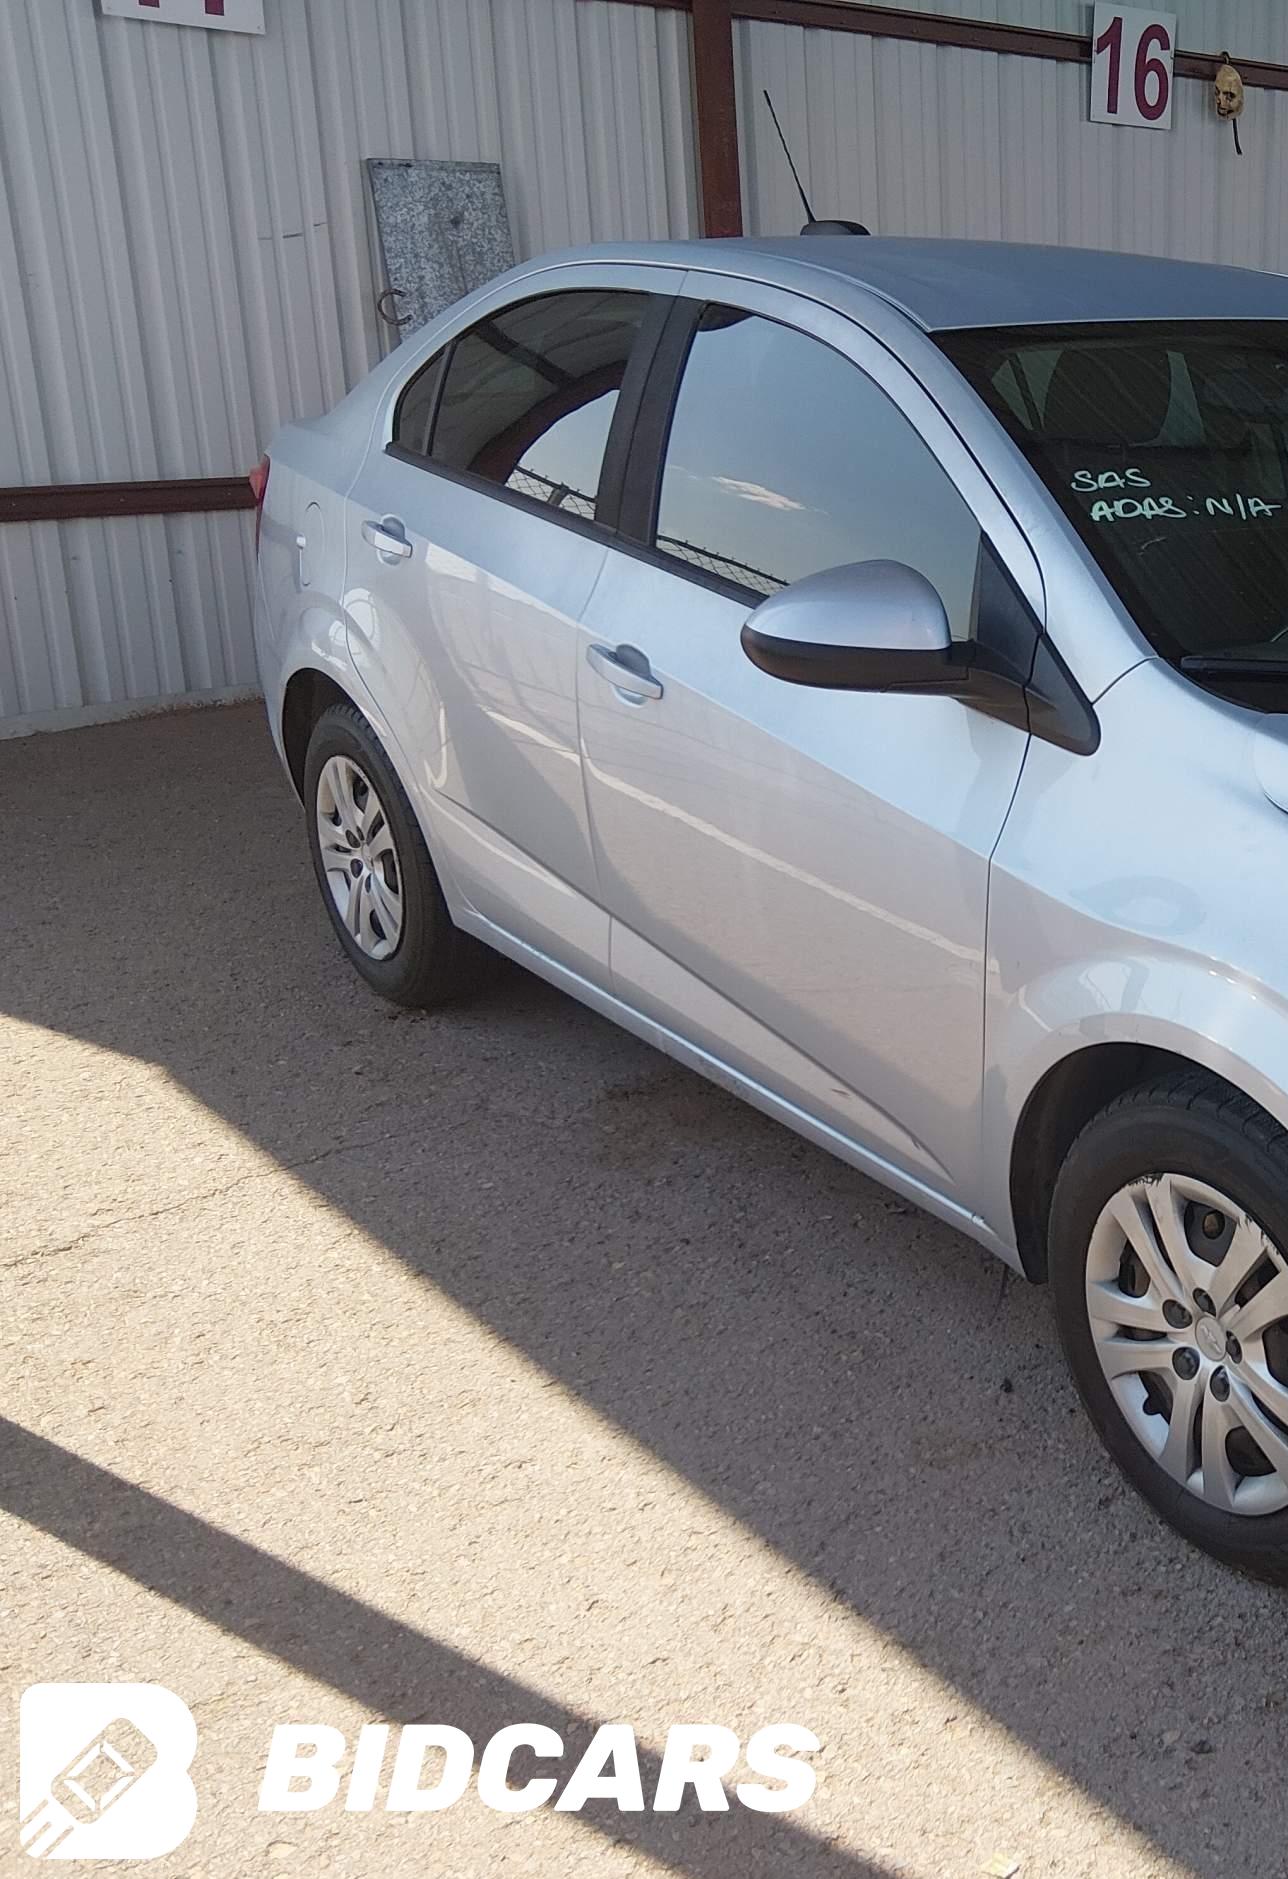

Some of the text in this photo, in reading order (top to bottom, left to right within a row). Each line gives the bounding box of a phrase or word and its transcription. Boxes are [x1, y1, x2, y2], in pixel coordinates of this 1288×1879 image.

[1095, 16, 1171, 121] 16
[1070, 468, 1151, 492] SAS
[1205, 493, 1282, 520] N/A
